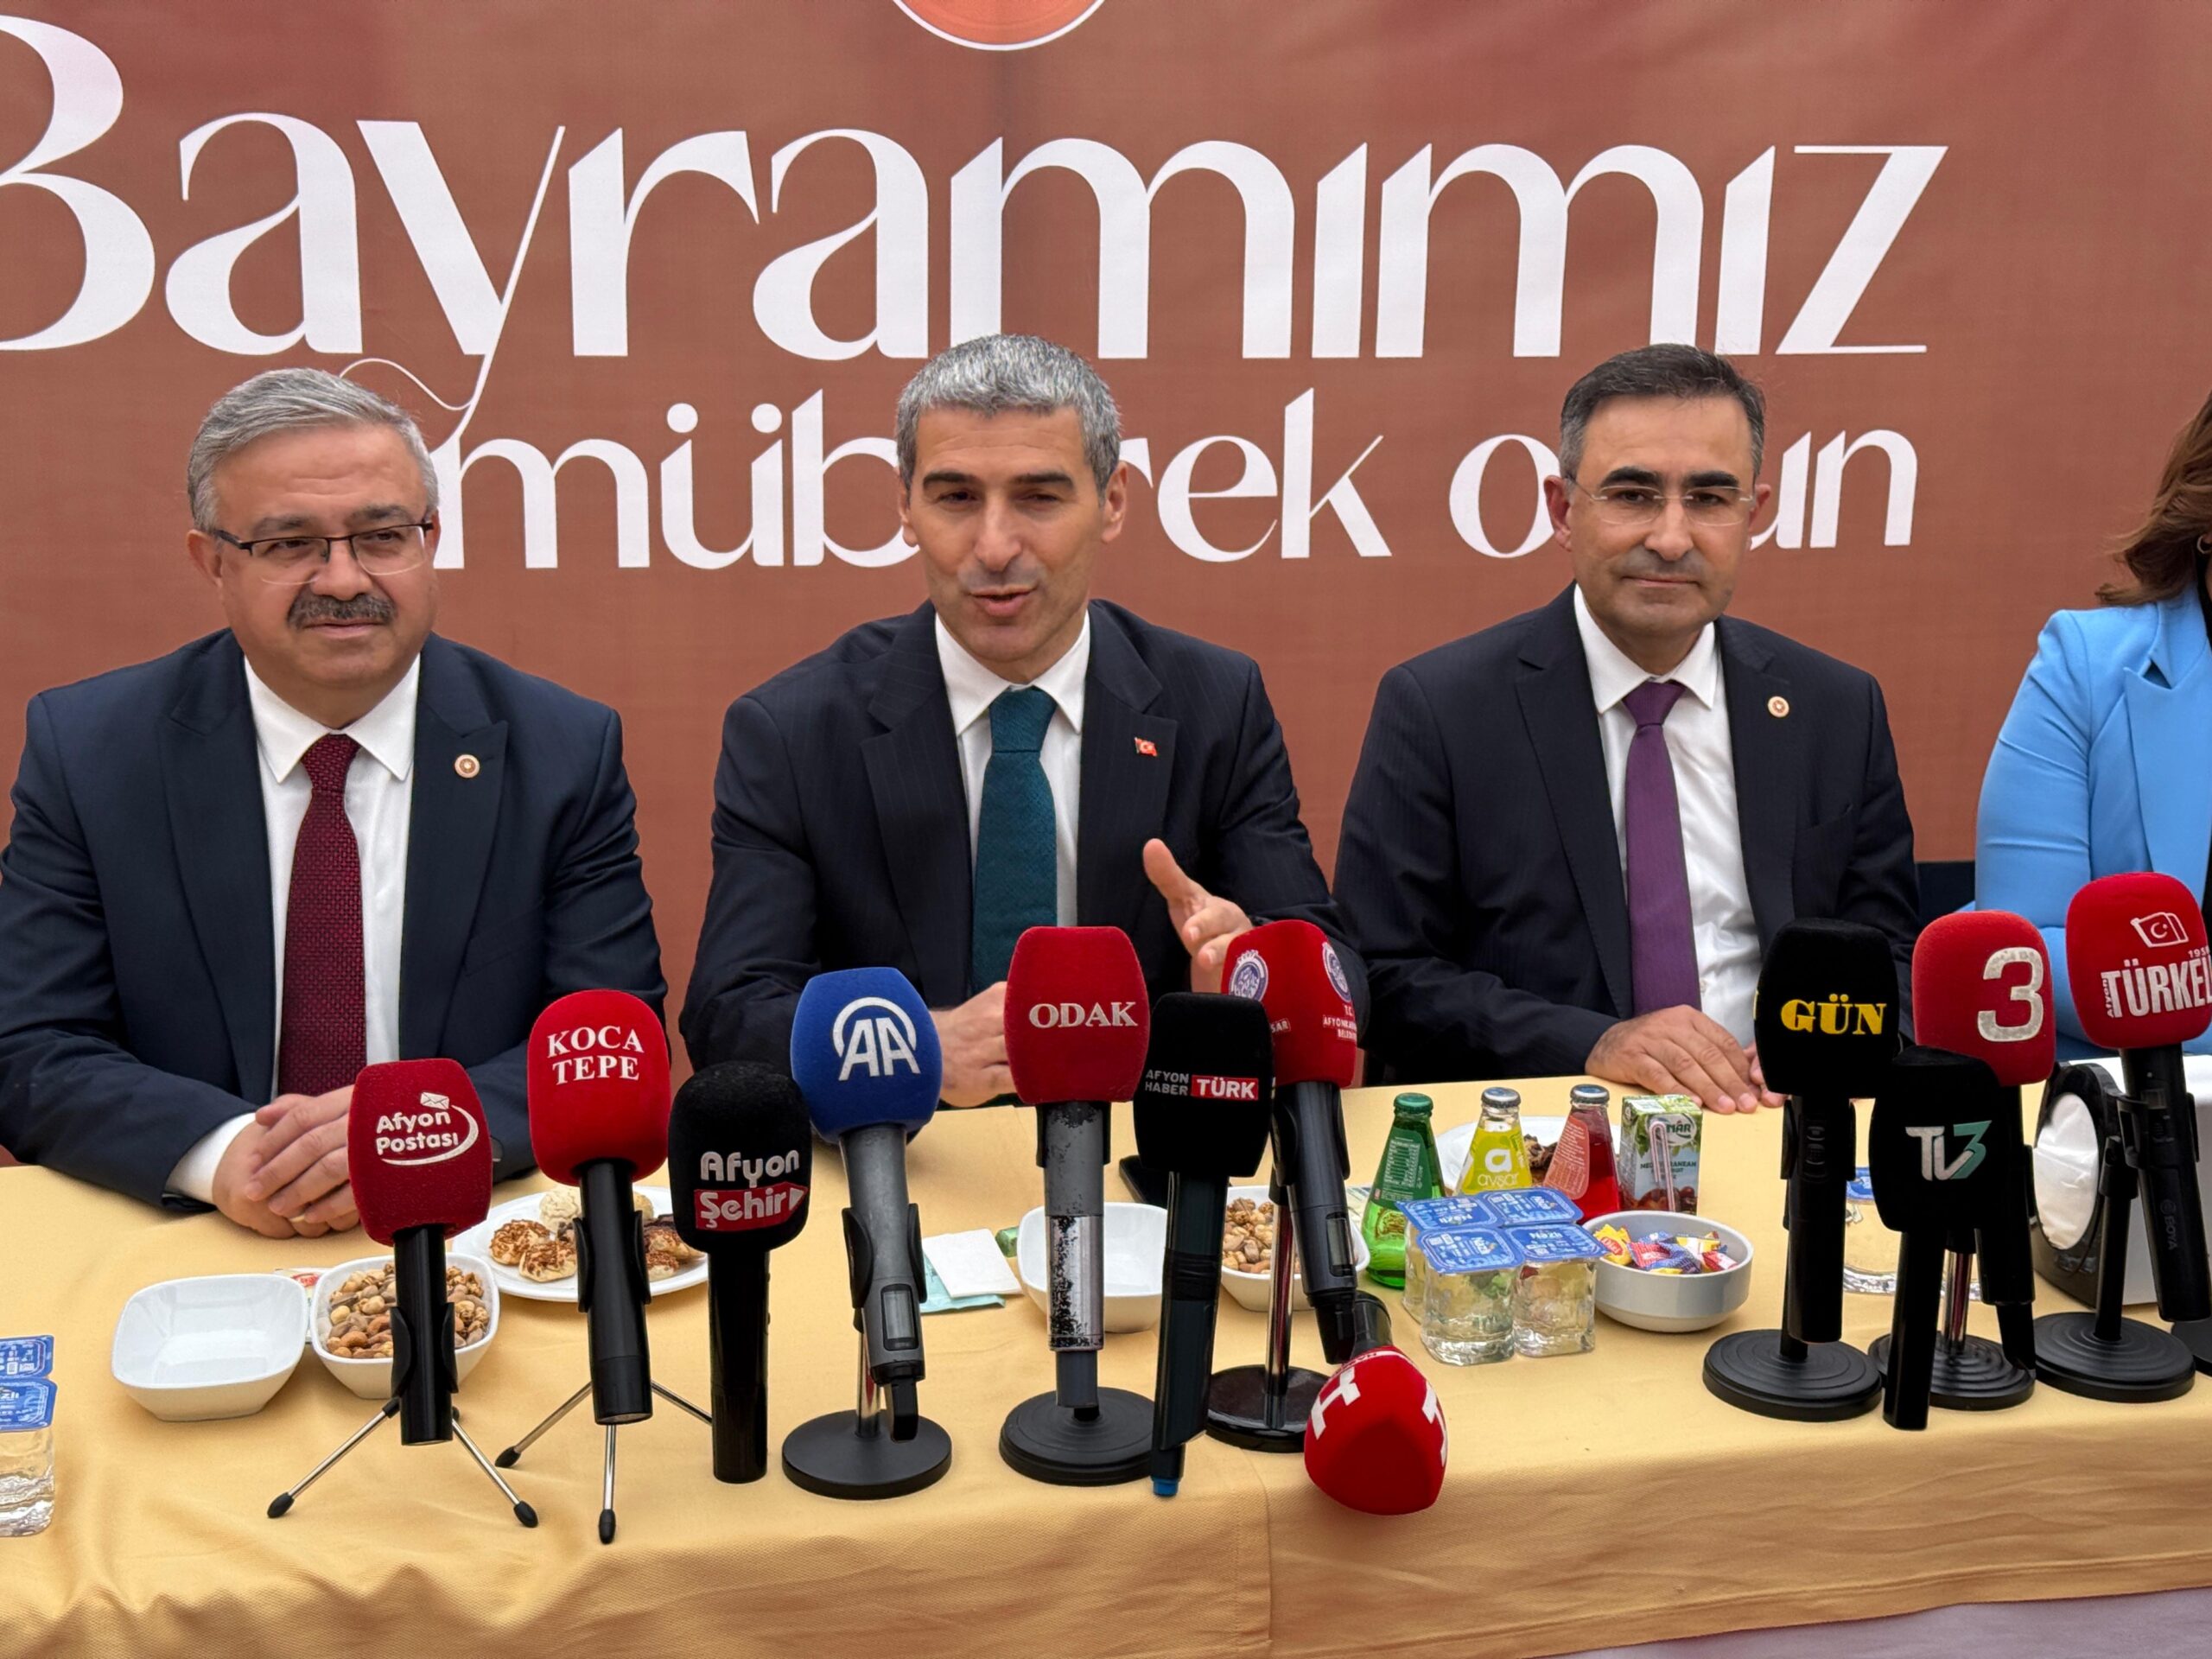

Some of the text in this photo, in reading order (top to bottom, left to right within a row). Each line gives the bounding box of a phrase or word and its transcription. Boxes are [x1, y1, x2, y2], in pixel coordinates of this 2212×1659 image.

[0, 16, 1948, 432] Bayramımız
[432, 388, 1392, 570] mübek
[1977, 946, 2044, 1043] 3
[1028, 1001, 1139, 1029] ODAK
[1781, 994, 1887, 1035] GÜN
[547, 1025, 645, 1058] KOCA
[835, 1007, 921, 1082] AA
[551, 1055, 640, 1085] TEPE
[1146, 1070, 1256, 1099] AFYON TÜRK
[1144, 1082, 1189, 1096] HABER
[376, 1109, 452, 1135] Afyon
[375, 1130, 460, 1156] Postası
[700, 1149, 800, 1187] Afyon
[699, 1186, 786, 1229] Şehir
[2164, 1215, 2178, 1251] BOYA
